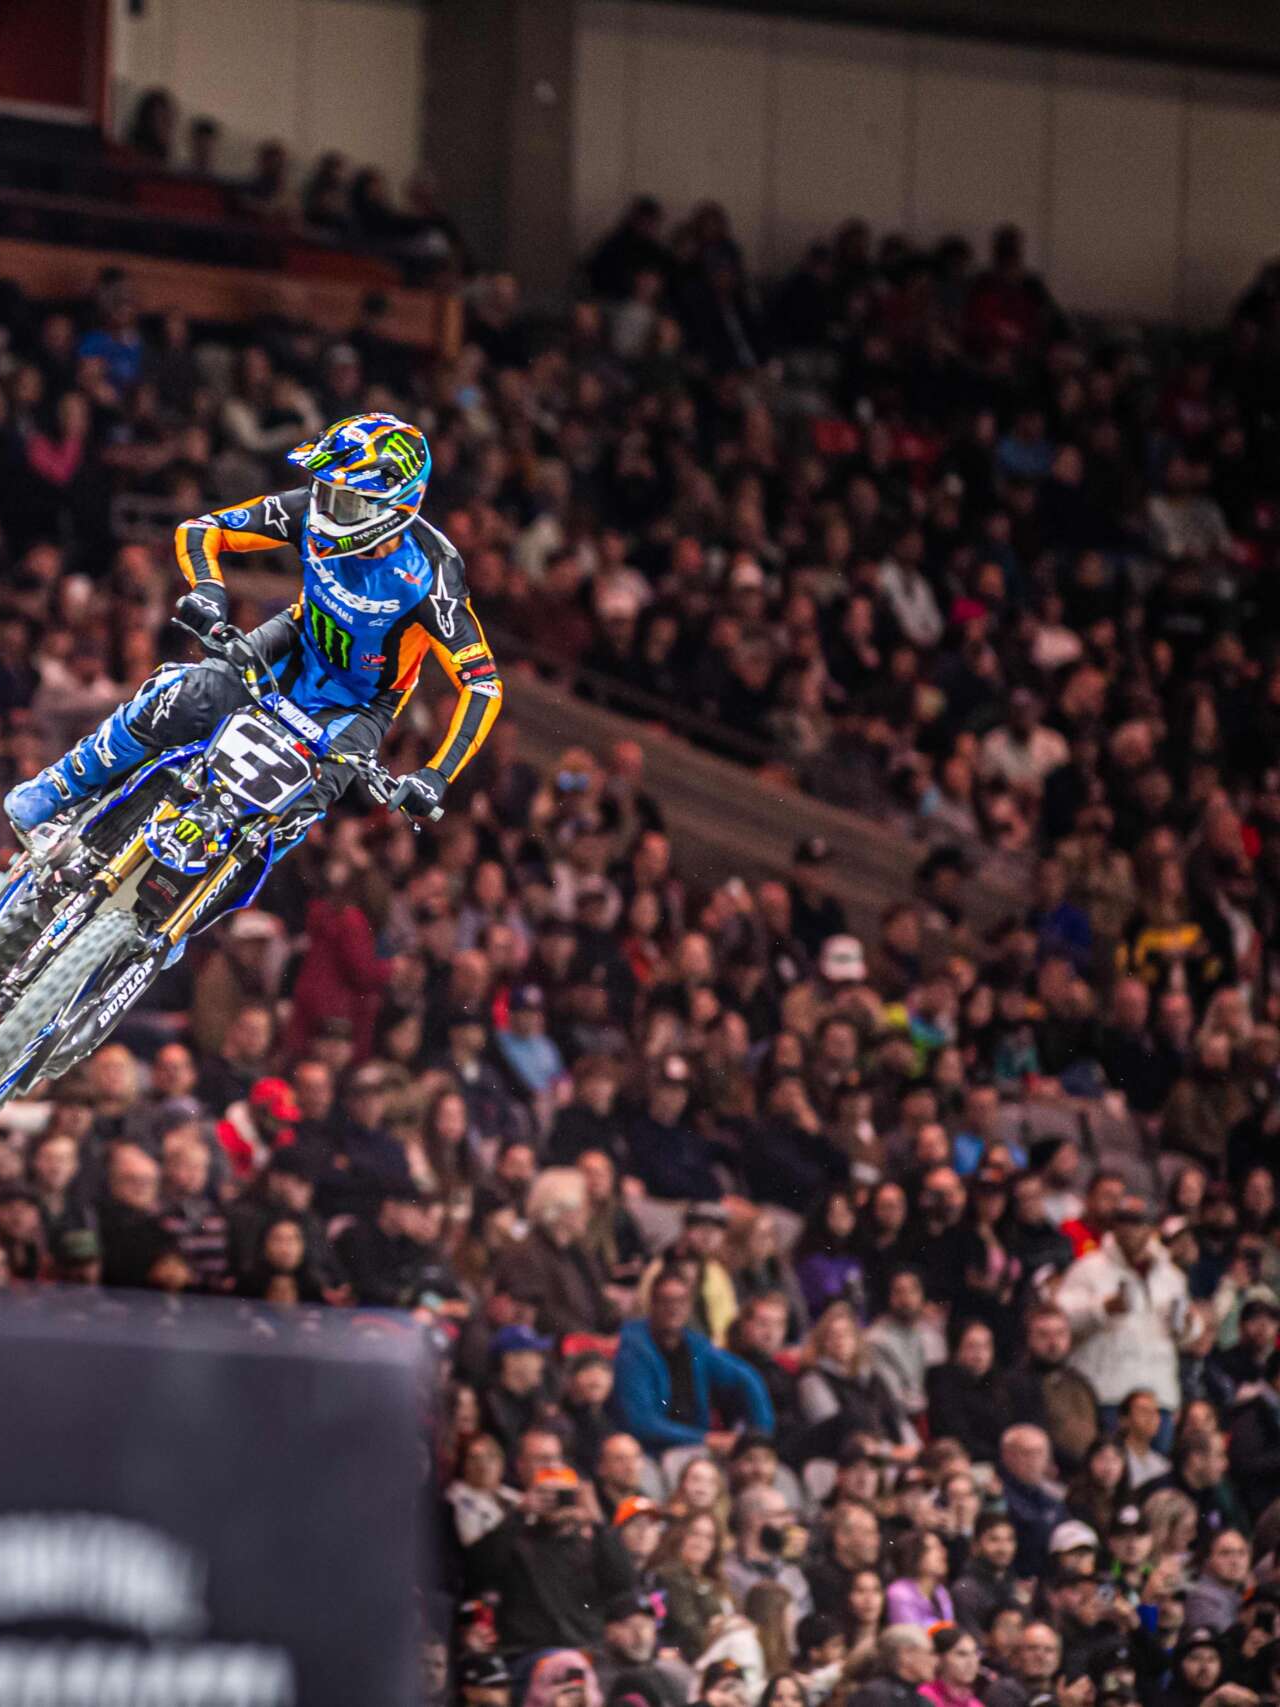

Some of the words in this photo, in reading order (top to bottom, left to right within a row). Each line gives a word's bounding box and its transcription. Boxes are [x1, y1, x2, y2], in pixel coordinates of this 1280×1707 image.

[306, 557, 400, 614] pinestars
[321, 594, 353, 625] YAMAHA
[212, 722, 308, 805] 3
[98, 957, 154, 1028] DUNLOP
